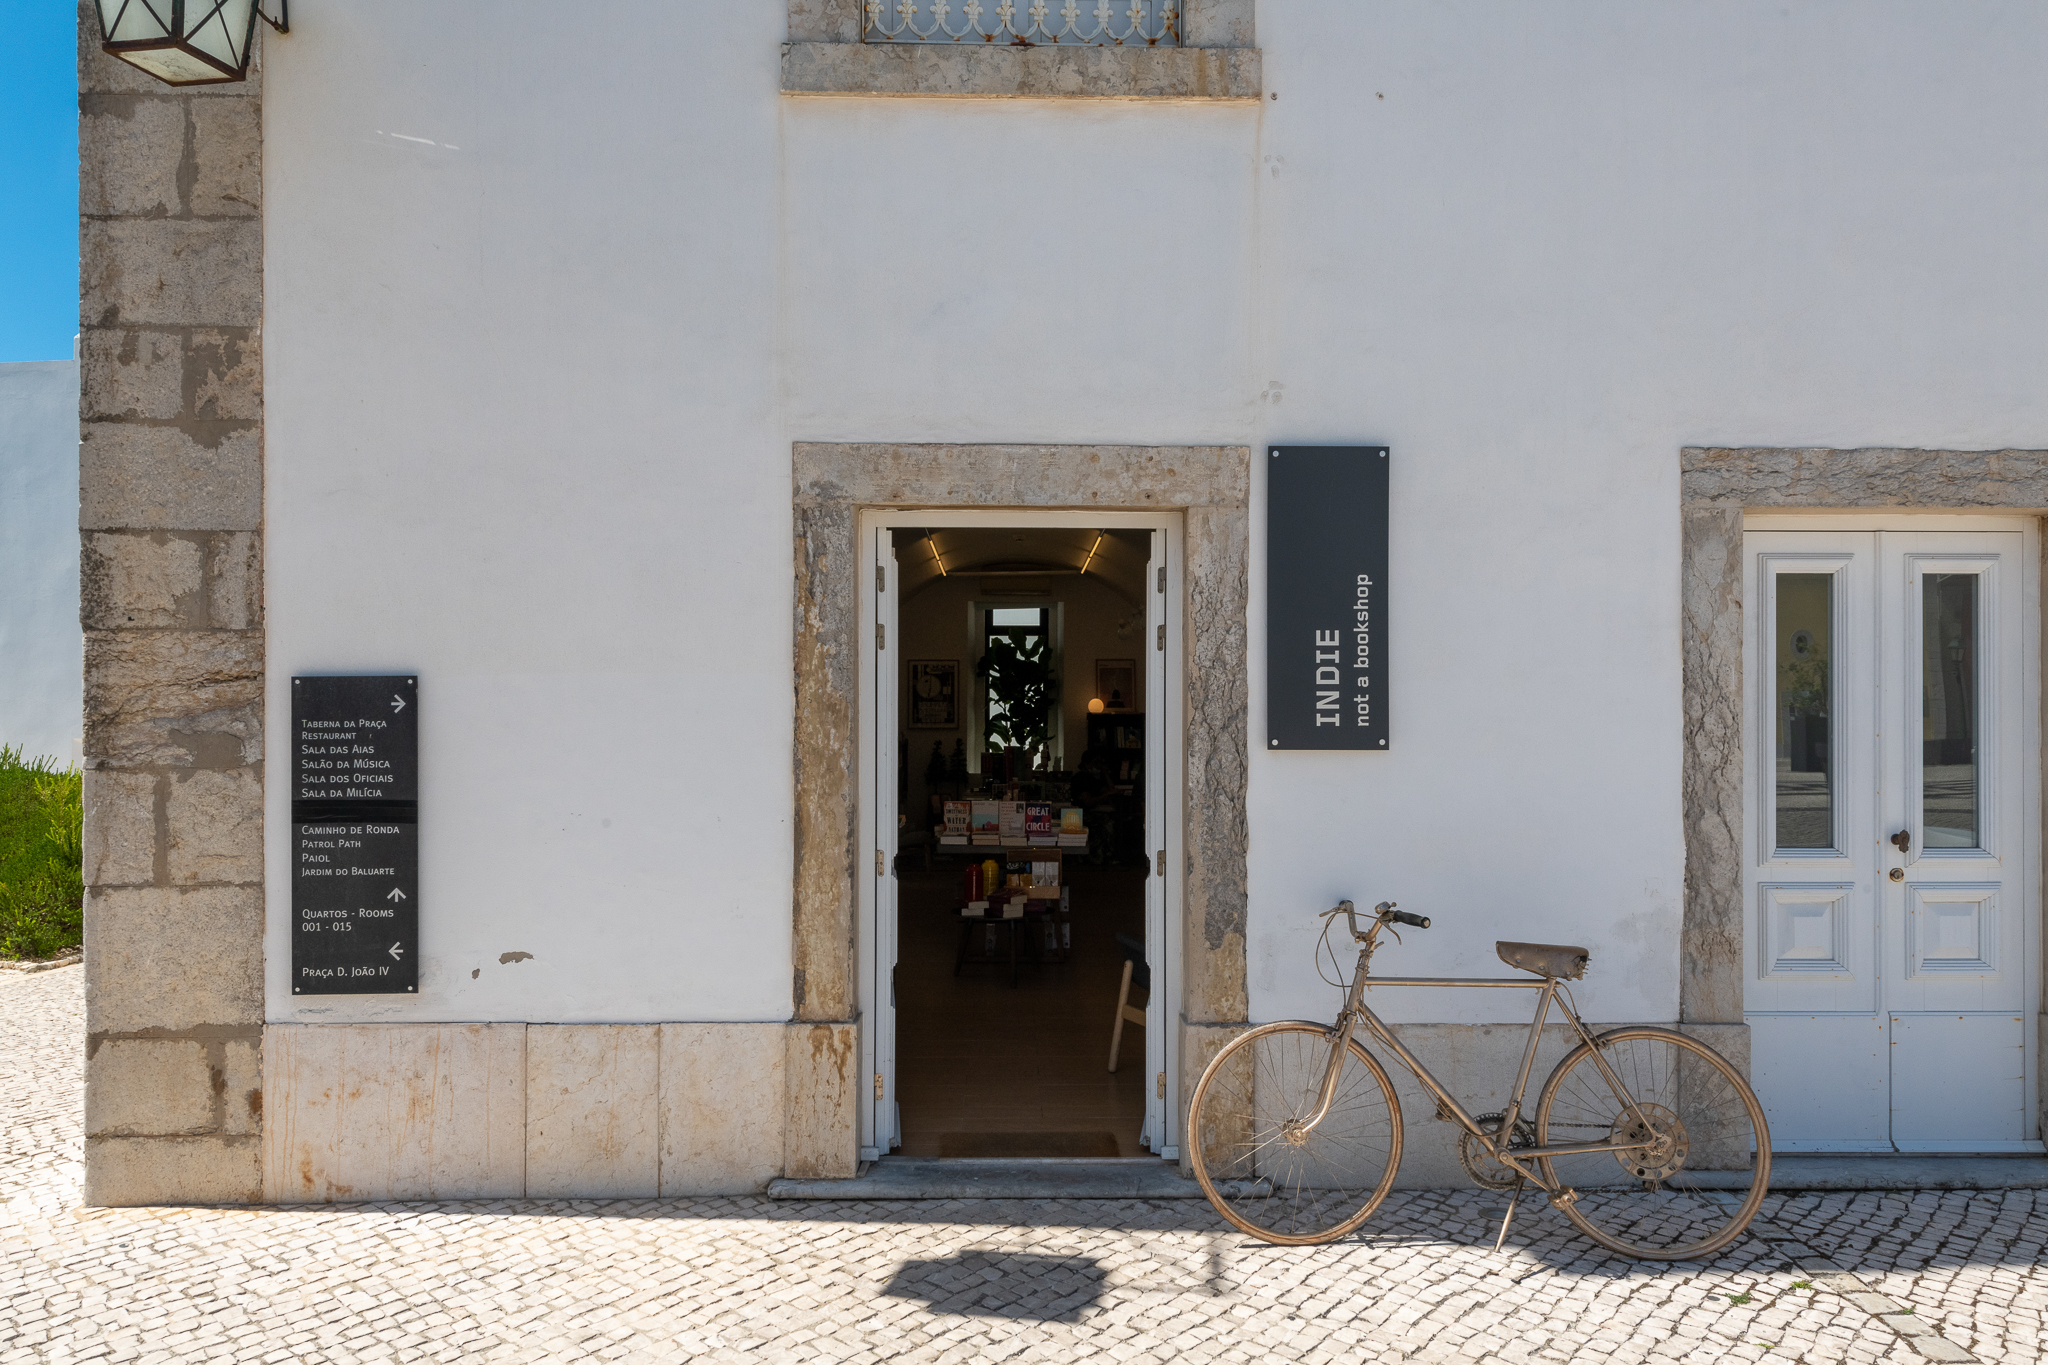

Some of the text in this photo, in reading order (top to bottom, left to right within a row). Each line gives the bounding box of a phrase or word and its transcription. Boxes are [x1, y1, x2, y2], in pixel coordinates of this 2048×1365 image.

[1353, 574, 1373, 727] not a bookshop
[1315, 629, 1340, 727] INDIE
[301, 718, 387, 730] TABERNA DA PRAÇA
[301, 731, 357, 740] RESTAURANT
[301, 744, 375, 754] SALA DAS AIAS
[301, 758, 391, 769] SALÃO DA MÚSICA
[301, 772, 394, 783] SALA DOS OFICIAIS
[301, 787, 383, 798] SALA DA MILÍCIA
[1026, 806, 1050, 817] GREAT
[946, 817, 967, 825] WATER
[1025, 821, 1051, 832] CIRCLE
[301, 824, 400, 835] CAMINHO DE RONDA
[302, 839, 361, 848] PATROL PATH
[302, 853, 331, 863] PAIOL
[301, 866, 395, 877] JARDIM DO BALUARTE
[302, 908, 348, 919] QUARTOS
[358, 908, 394, 918] ROOMS
[302, 922, 321, 932] 001
[332, 921, 352, 932] 015
[302, 966, 390, 979] PRAÇA D. JOÃO IV
